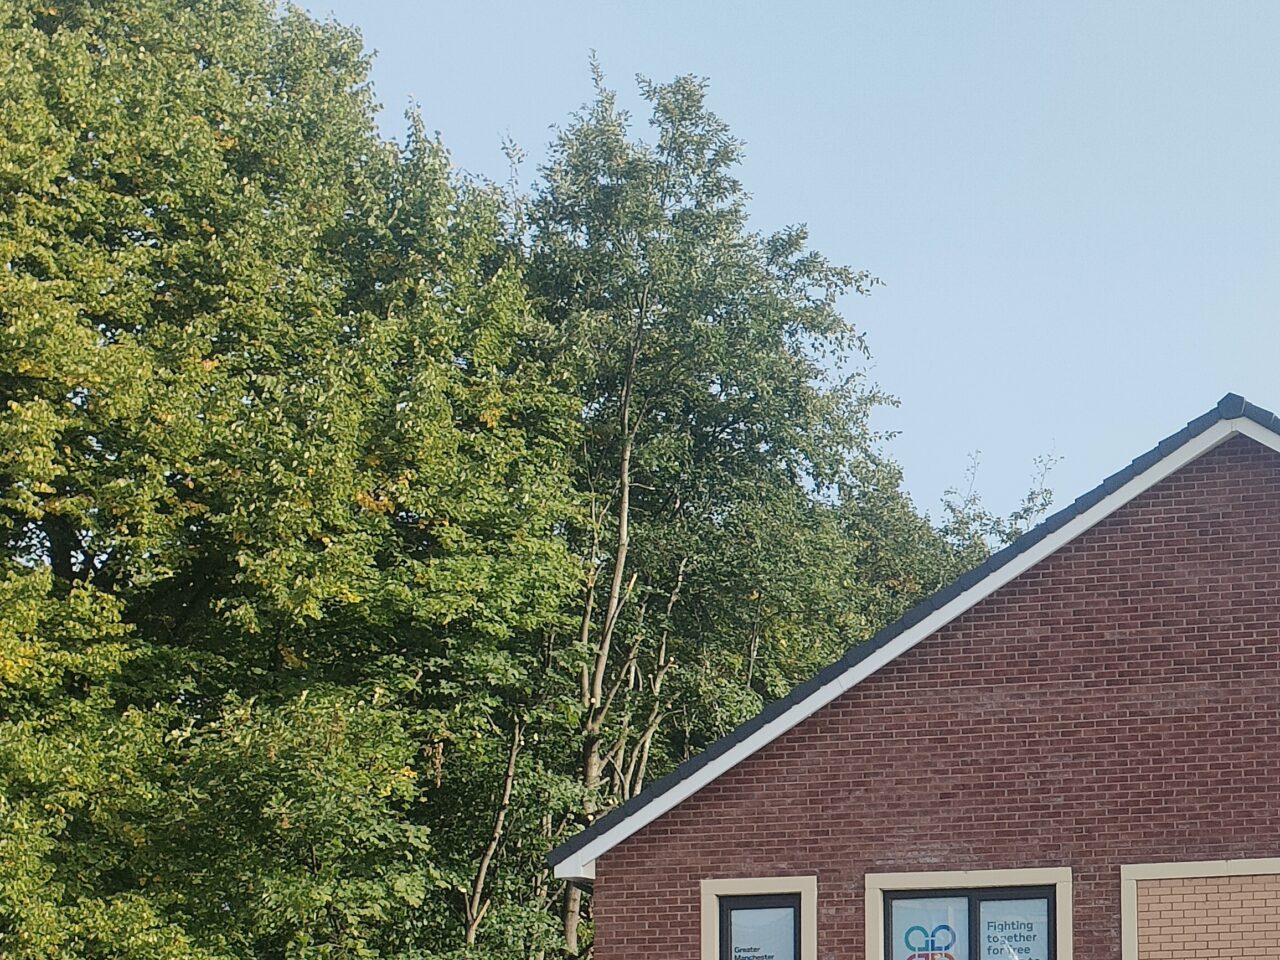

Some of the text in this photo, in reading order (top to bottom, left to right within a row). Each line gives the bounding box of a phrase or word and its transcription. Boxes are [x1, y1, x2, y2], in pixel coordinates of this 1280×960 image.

[987, 921, 1033, 932] Fighting
[987, 933, 1037, 945] together
[987, 945, 1004, 955] for
